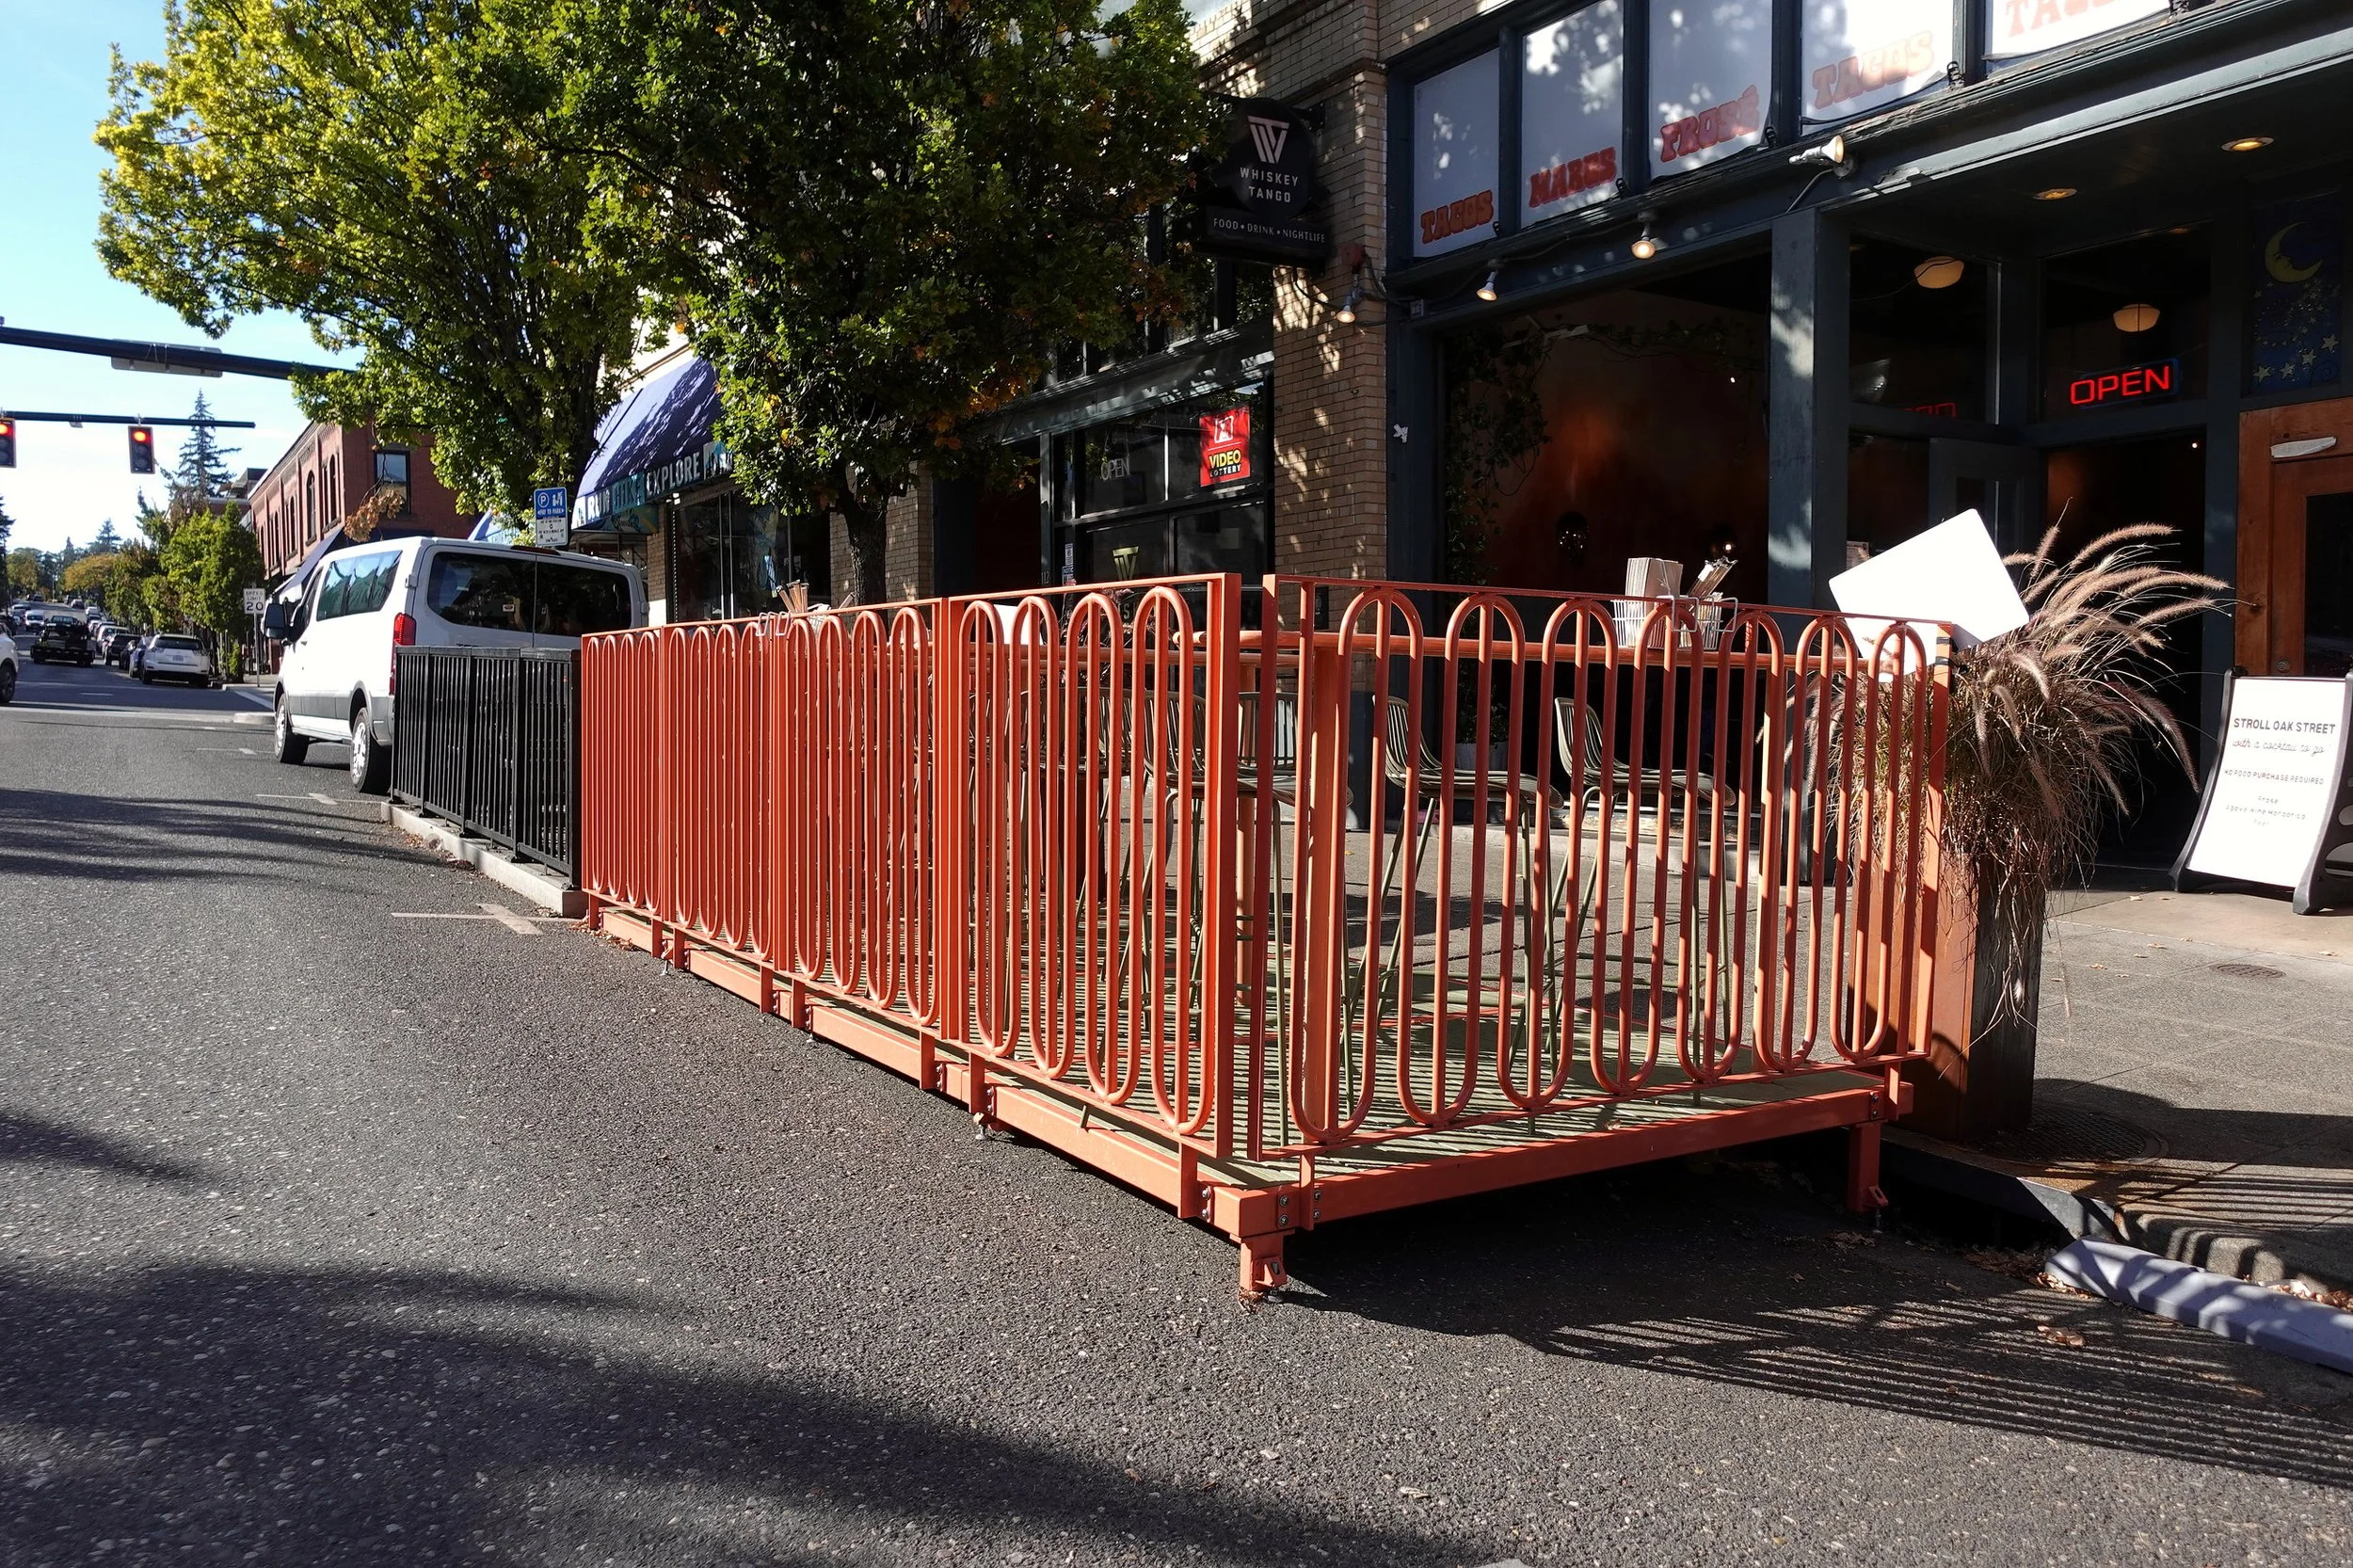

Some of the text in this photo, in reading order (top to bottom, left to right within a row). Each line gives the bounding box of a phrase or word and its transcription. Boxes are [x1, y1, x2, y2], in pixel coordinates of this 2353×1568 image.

[1812, 29, 1934, 110] TACOS
[1240, 167, 1299, 186] WHISKEY
[1248, 185, 1291, 203] TANGO
[1420, 189, 1495, 245] TACOS
[1213, 217, 1326, 244] FOOD DRINK NIGHTLIFE
[2070, 365, 2169, 405] OPEN
[1100, 457, 1129, 481] OPEN
[1209, 449, 1241, 469] VIDEO
[1209, 464, 1241, 477] LOTTERY
[587, 488, 610, 522] RUN
[646, 451, 700, 496] EXPLORE
[246, 601, 264, 611] 20
[2233, 717, 2336, 734] STROLL OAK STREET
[2252, 772, 2288, 782] PURCHASE
[2290, 775, 2325, 785] REQUIRED
